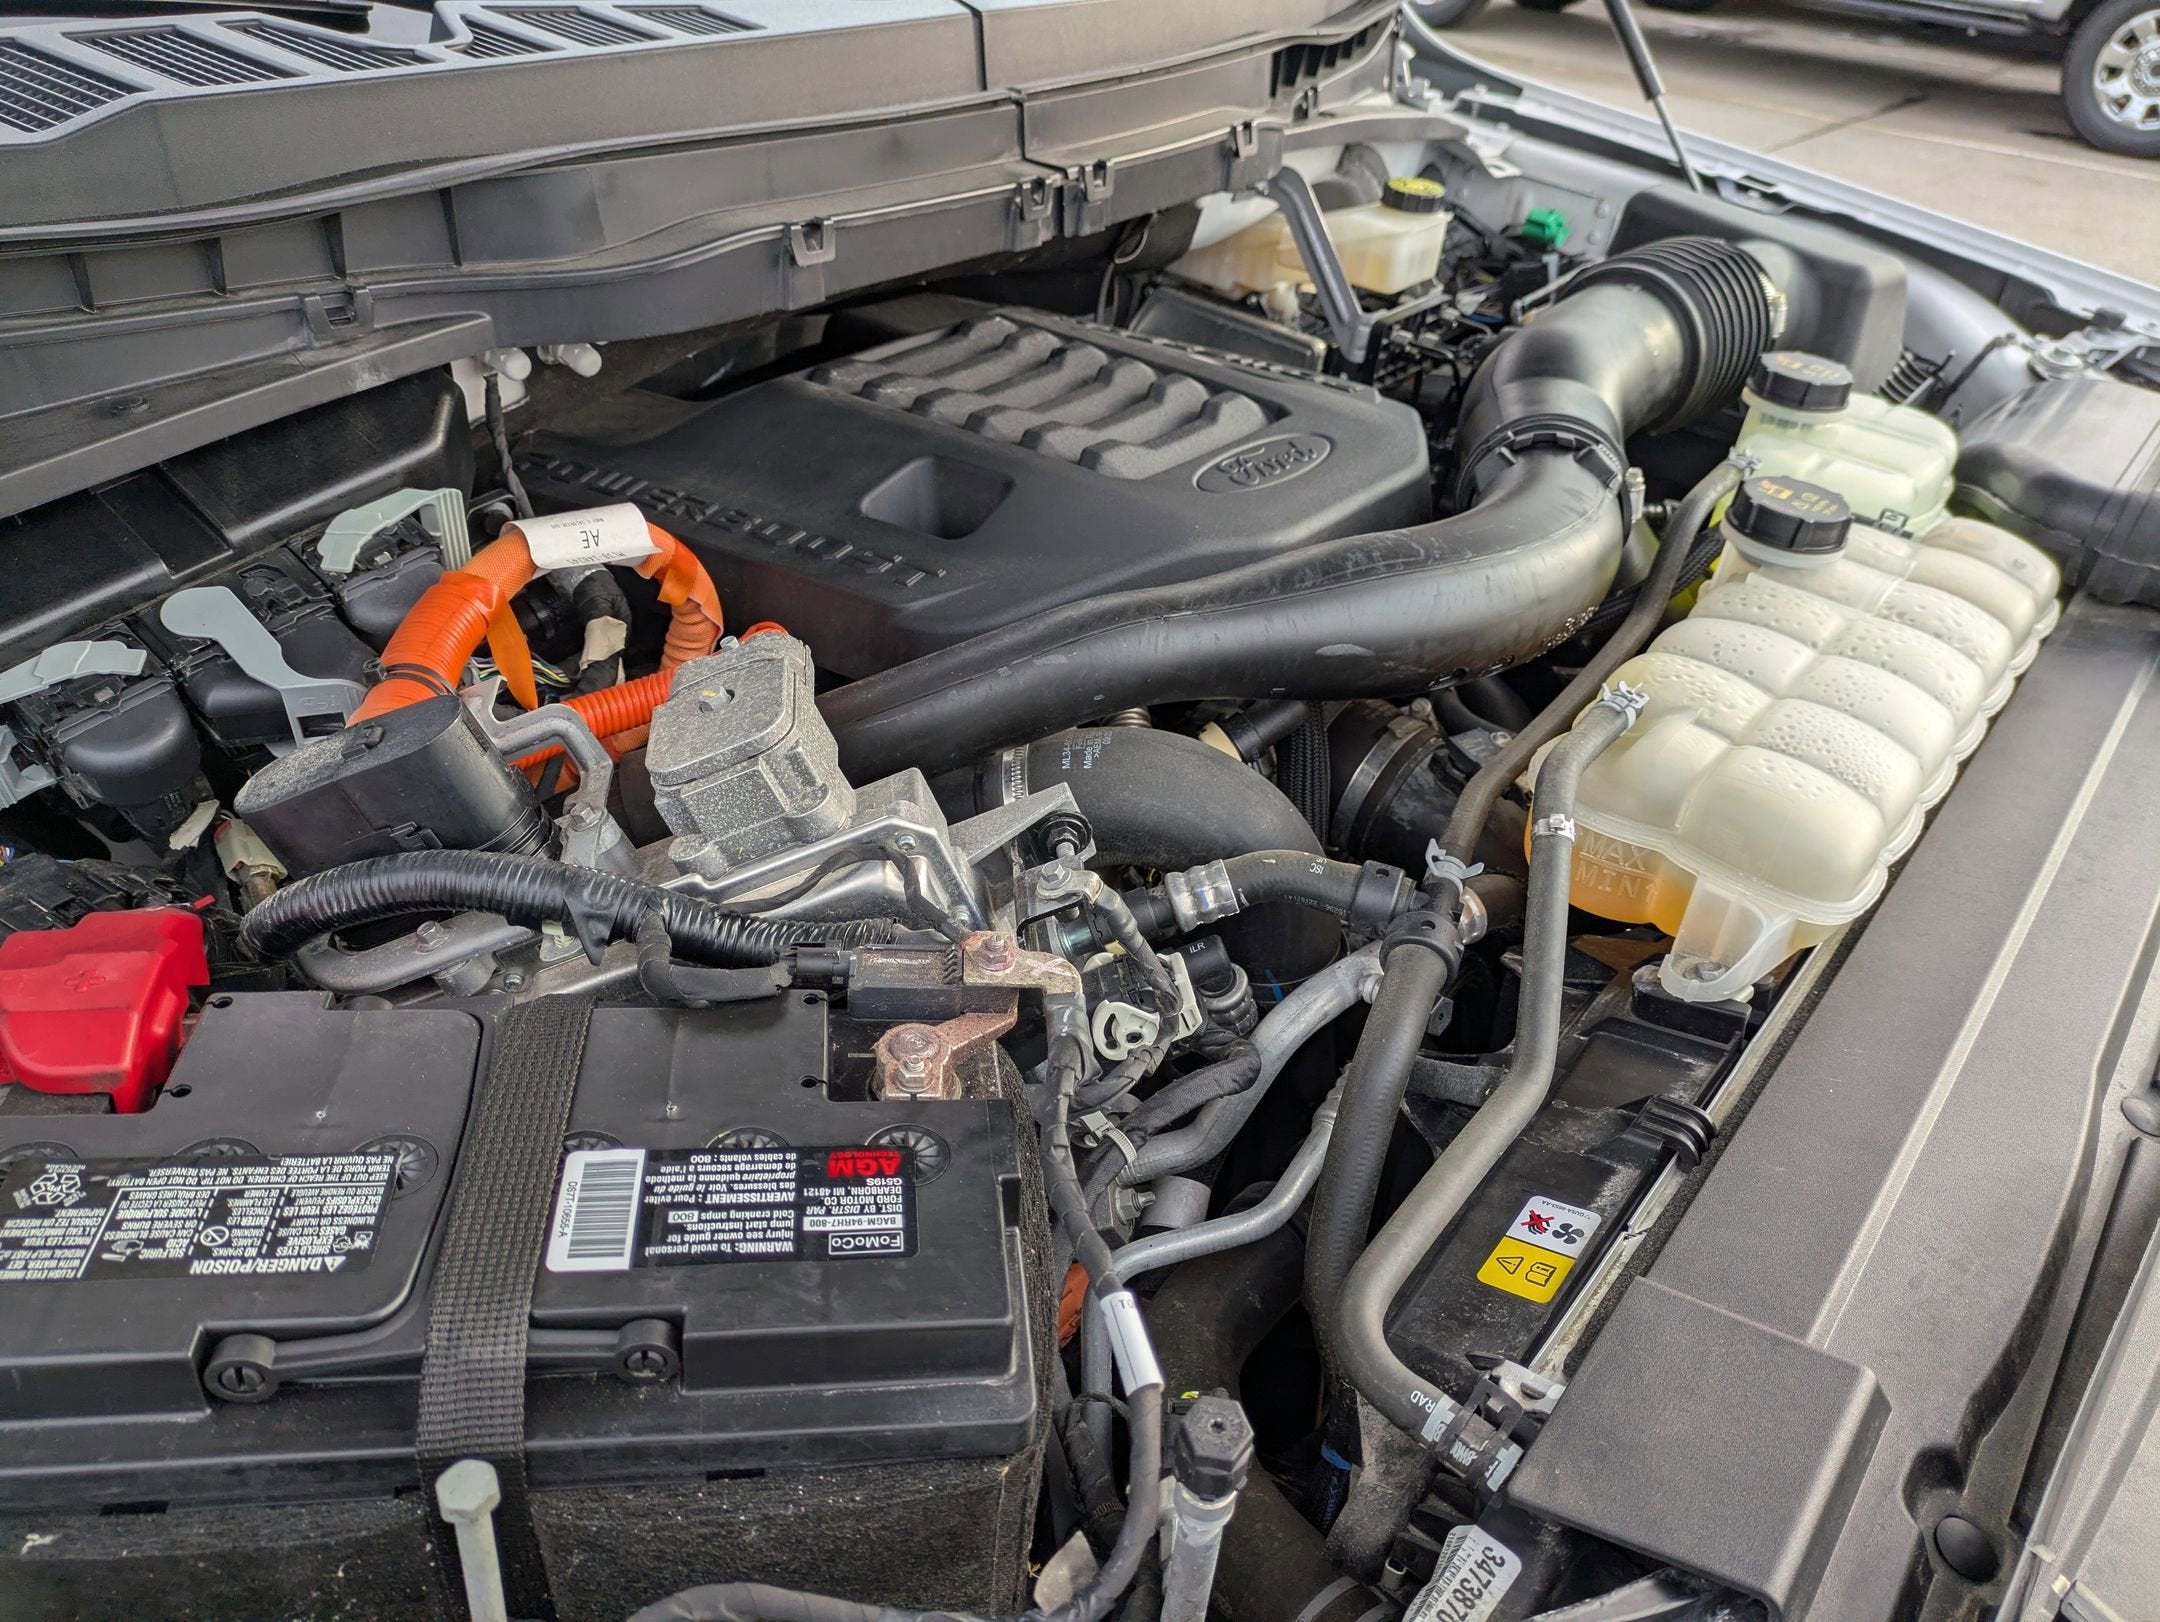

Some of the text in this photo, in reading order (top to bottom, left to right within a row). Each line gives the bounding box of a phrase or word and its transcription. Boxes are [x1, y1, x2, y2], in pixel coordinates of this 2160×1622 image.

[1216, 441, 1317, 486] Ford
[514, 452, 947, 588] POWERBOOST
[580, 529, 600, 549] AE
[1083, 745, 1093, 769] Made
[1583, 832, 1648, 871] MAX
[1309, 862, 1325, 876] ISC
[1576, 861, 1641, 898] MIN
[1189, 942, 1206, 955] ILR
[691, 1153, 796, 1163] de cables volants 800
[830, 1150, 900, 1158] TECHNOLOGY
[322, 1157, 333, 1165] LA
[333, 1156, 364, 1164] OUVRIR
[365, 1156, 382, 1164] PAS
[382, 1156, 394, 1164] NE
[270, 1167, 287, 1175] DES
[331, 1165, 343, 1173] DE
[343, 1164, 367, 1173] HORS
[368, 1164, 391, 1172] TENIR
[660, 1165, 686, 1174] l'aide
[697, 1164, 732, 1172] secours
[734, 1162, 782, 1172] demarrage
[785, 1162, 796, 1170] de
[827, 1158, 900, 1178] AGM
[199, 1168, 216, 1176] PAS
[216, 1167, 229, 1176] NE
[147, 1177, 168, 1186] OPEN
[169, 1176, 185, 1185] NOT
[186, 1177, 198, 1185] DO
[232, 1176, 245, 1184] DO
[299, 1174, 325, 1182] REACH
[325, 1174, 339, 1182] THE
[353, 1173, 368, 1181] OUT
[369, 1173, 389, 1181] KEEP
[645, 1175, 685, 1184] methode
[688, 1175, 696, 1183] la
[290, 1186, 384, 1197] BLESSER OU RENDRE AVEUGLE
[654, 1182, 796, 1194] des blessures. Voir le guide du
[803, 1186, 902, 1196] DEARBORN, MI 48121
[128, 1190, 211, 1200] DES GRAVES
[244, 1189, 280, 1198] DE FUMER
[674, 1194, 696, 1203] Pour
[704, 1192, 795, 1204] AVERTISSEMENT
[119, 1200, 130, 1209] OU
[155, 1200, 163, 1208] LA
[163, 1200, 189, 1208] CAUSER
[262, 1198, 276, 1207] LES
[294, 1196, 382, 1206] GAZ EXPLOSIFS PEUVENT
[821, 1195, 902, 1205] FORD MOTOR CO.
[115, 1208, 169, 1219] SULFURIQUE
[283, 1207, 299, 1216] LES
[300, 1206, 320, 1215] YEUX
[322, 1206, 338, 1215] LES
[558, 1181, 578, 1238] DS7T-10655-A
[806, 1204, 902, 1215] DIST. BY DISTR. PAR
[672, 1210, 794, 1221] Cold cranking amps 800
[41, 1217, 101, 1227] CONSULTEZ UN
[121, 1220, 198, 1230] OR SEVERE BURNS
[226, 1217, 240, 1225] LES
[290, 1216, 375, 1227] BLINDNESS OR INJURY
[684, 1219, 794, 1231] jump start instructions.
[810, 1217, 896, 1227] BAGM-94RH7-800
[104, 1229, 193, 1240] CAN CAUSE BLINDNESS
[230, 1228, 265, 1237] SMOKING
[276, 1226, 347, 1237] GASES CAN CAUSE
[666, 1229, 794, 1243] injury see owner guide for
[22, 1237, 45, 1246] YEUX
[45, 1237, 63, 1246] LES
[165, 1238, 190, 1248] ACID
[286, 1235, 334, 1246] EXPLOSIVE
[832, 1235, 900, 1249] FoMoCo
[139, 1248, 186, 1259] SULFURIC
[244, 1248, 258, 1257] NO
[275, 1245, 331, 1256] SHIELD EYES
[645, 1241, 793, 1256] WARNING: To avoid personal
[31, 1249, 53, 1259] HELP
[5, 1260, 26, 1270] GET
[190, 1257, 323, 1274] DANGER/POISON
[25, 1269, 76, 1279] FLUSH EYES
[1410, 1389, 1437, 1414] RAD
